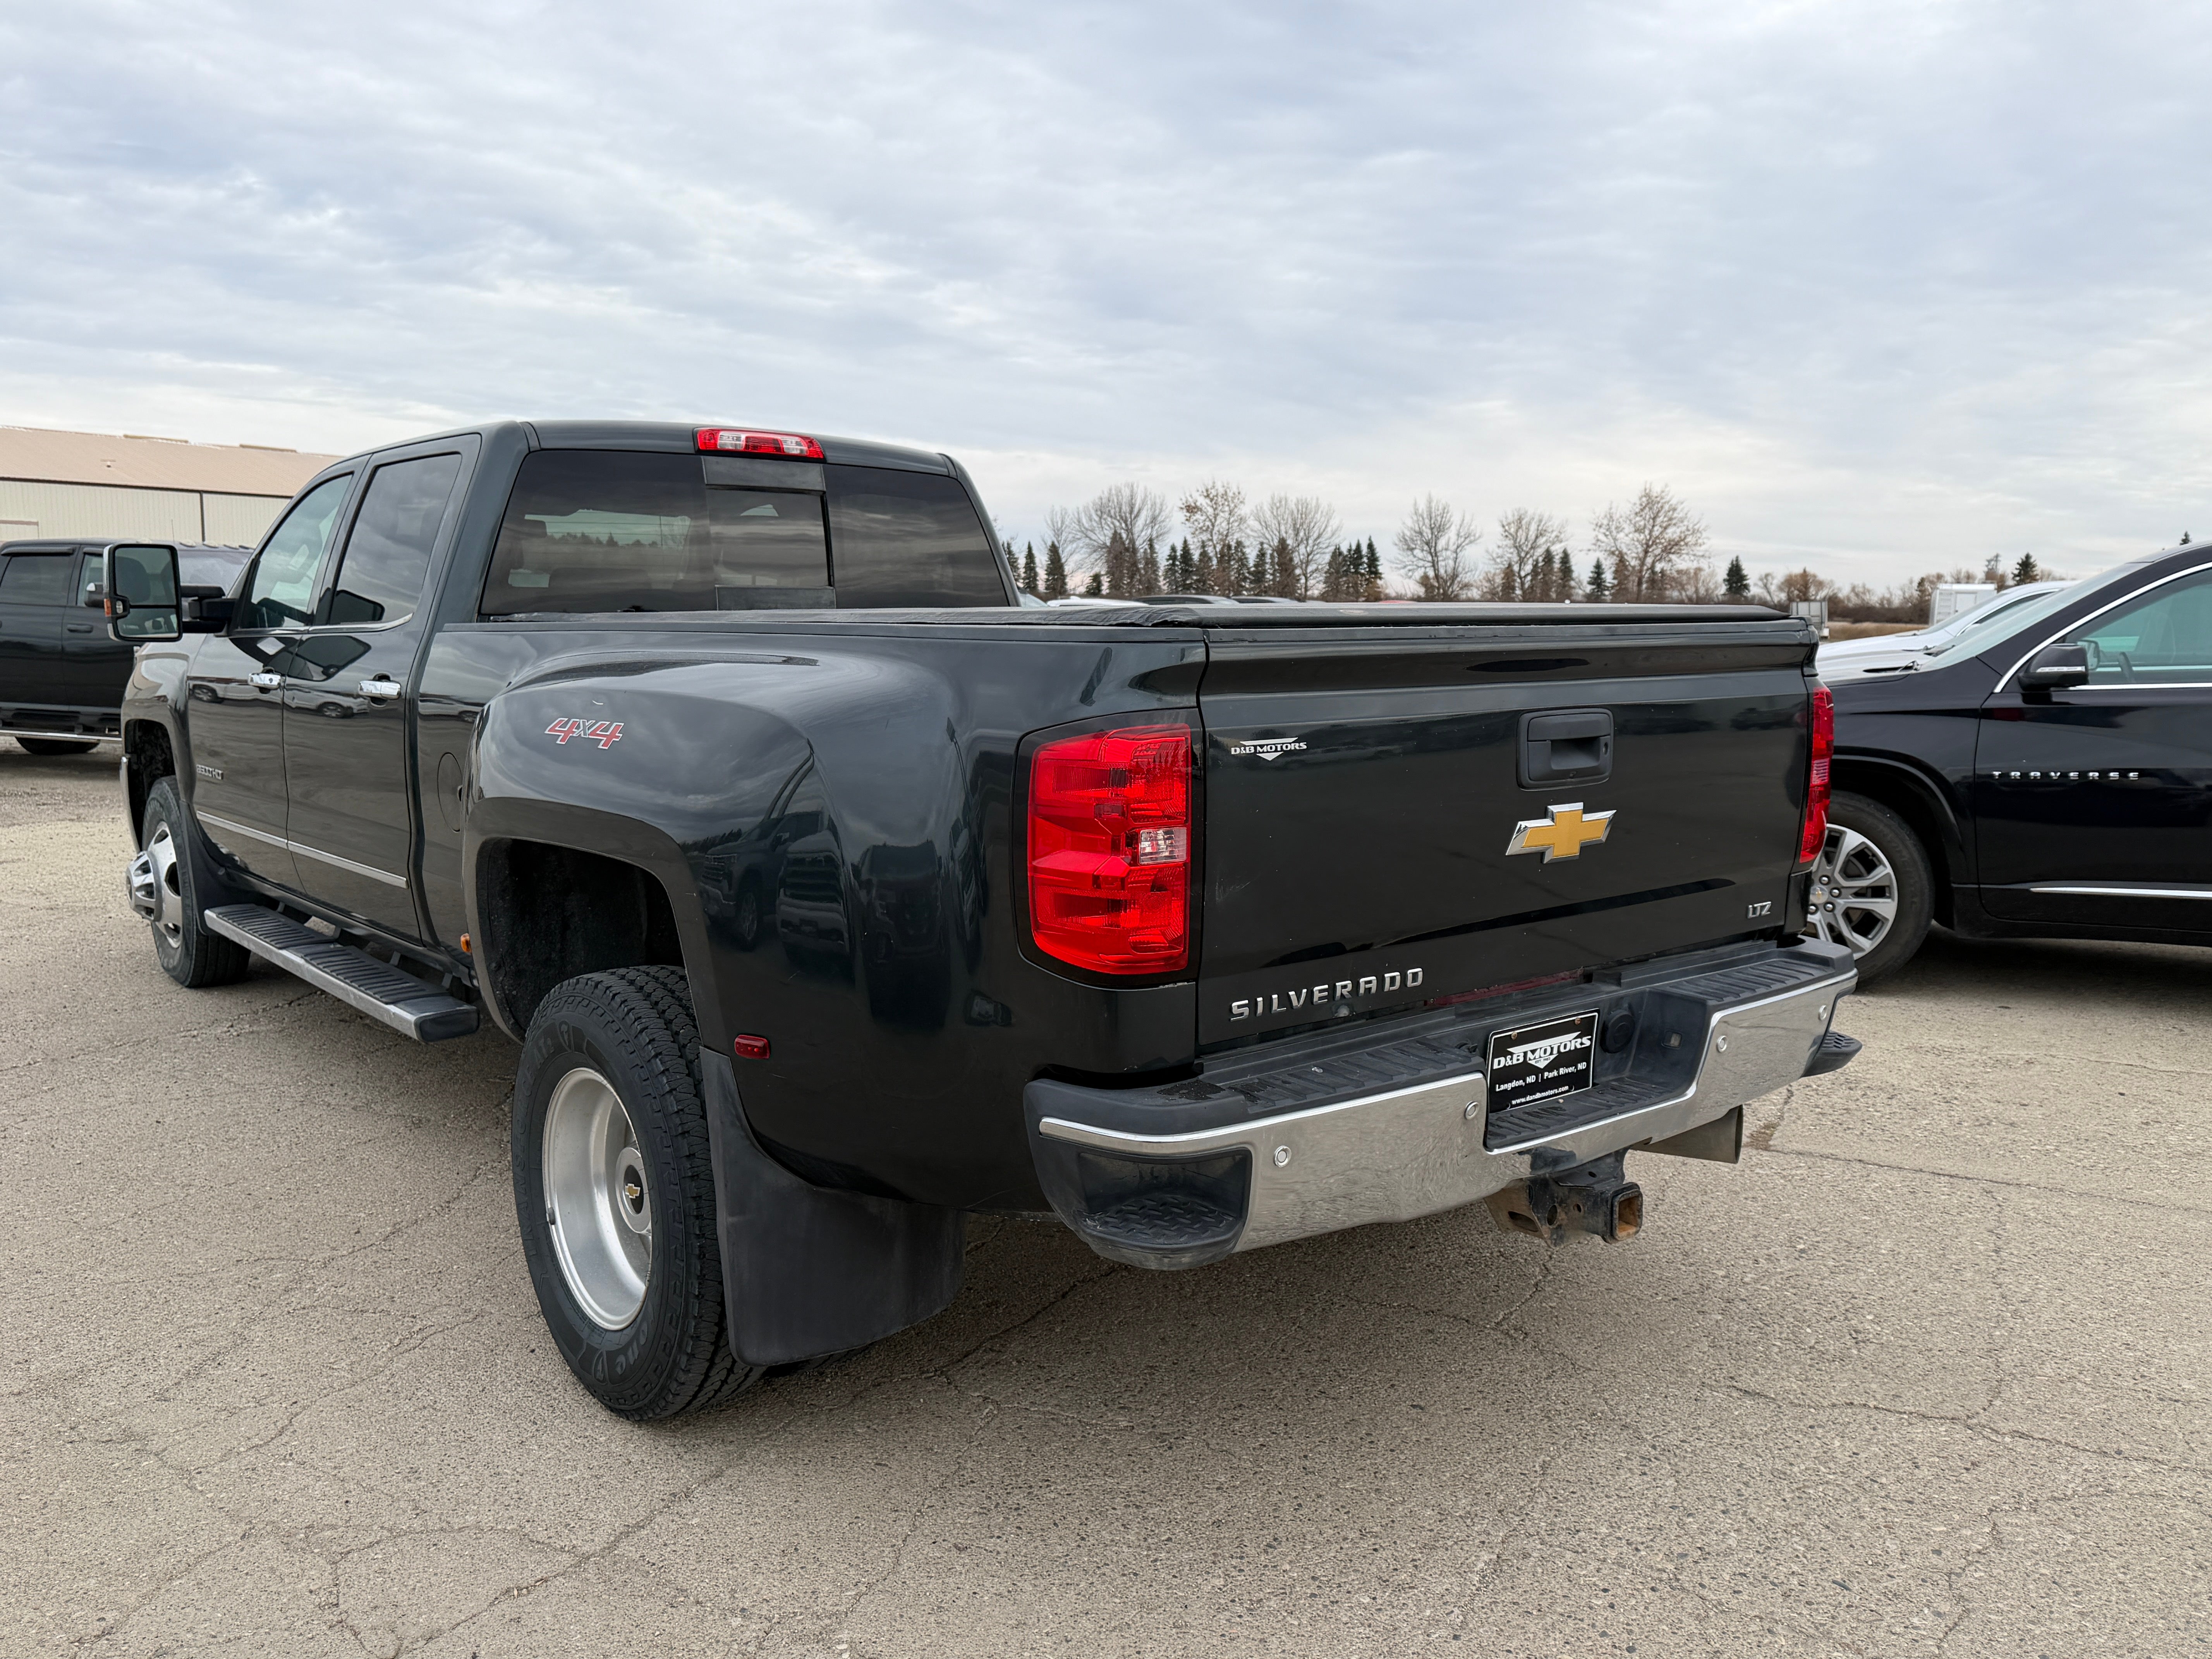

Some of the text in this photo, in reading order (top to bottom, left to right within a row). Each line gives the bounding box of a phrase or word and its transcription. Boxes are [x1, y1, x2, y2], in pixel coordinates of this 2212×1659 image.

[1231, 742, 1307, 755] D&B MOTORS
[1992, 771, 2139, 780] TRAVERSE
[1747, 901, 1772, 919] LTZ
[1229, 967, 1423, 1022] SILVERADO
[1493, 1035, 1592, 1070] D&B MOTORS
[1496, 1061, 1587, 1092] Langdon, ND Park River, ND
